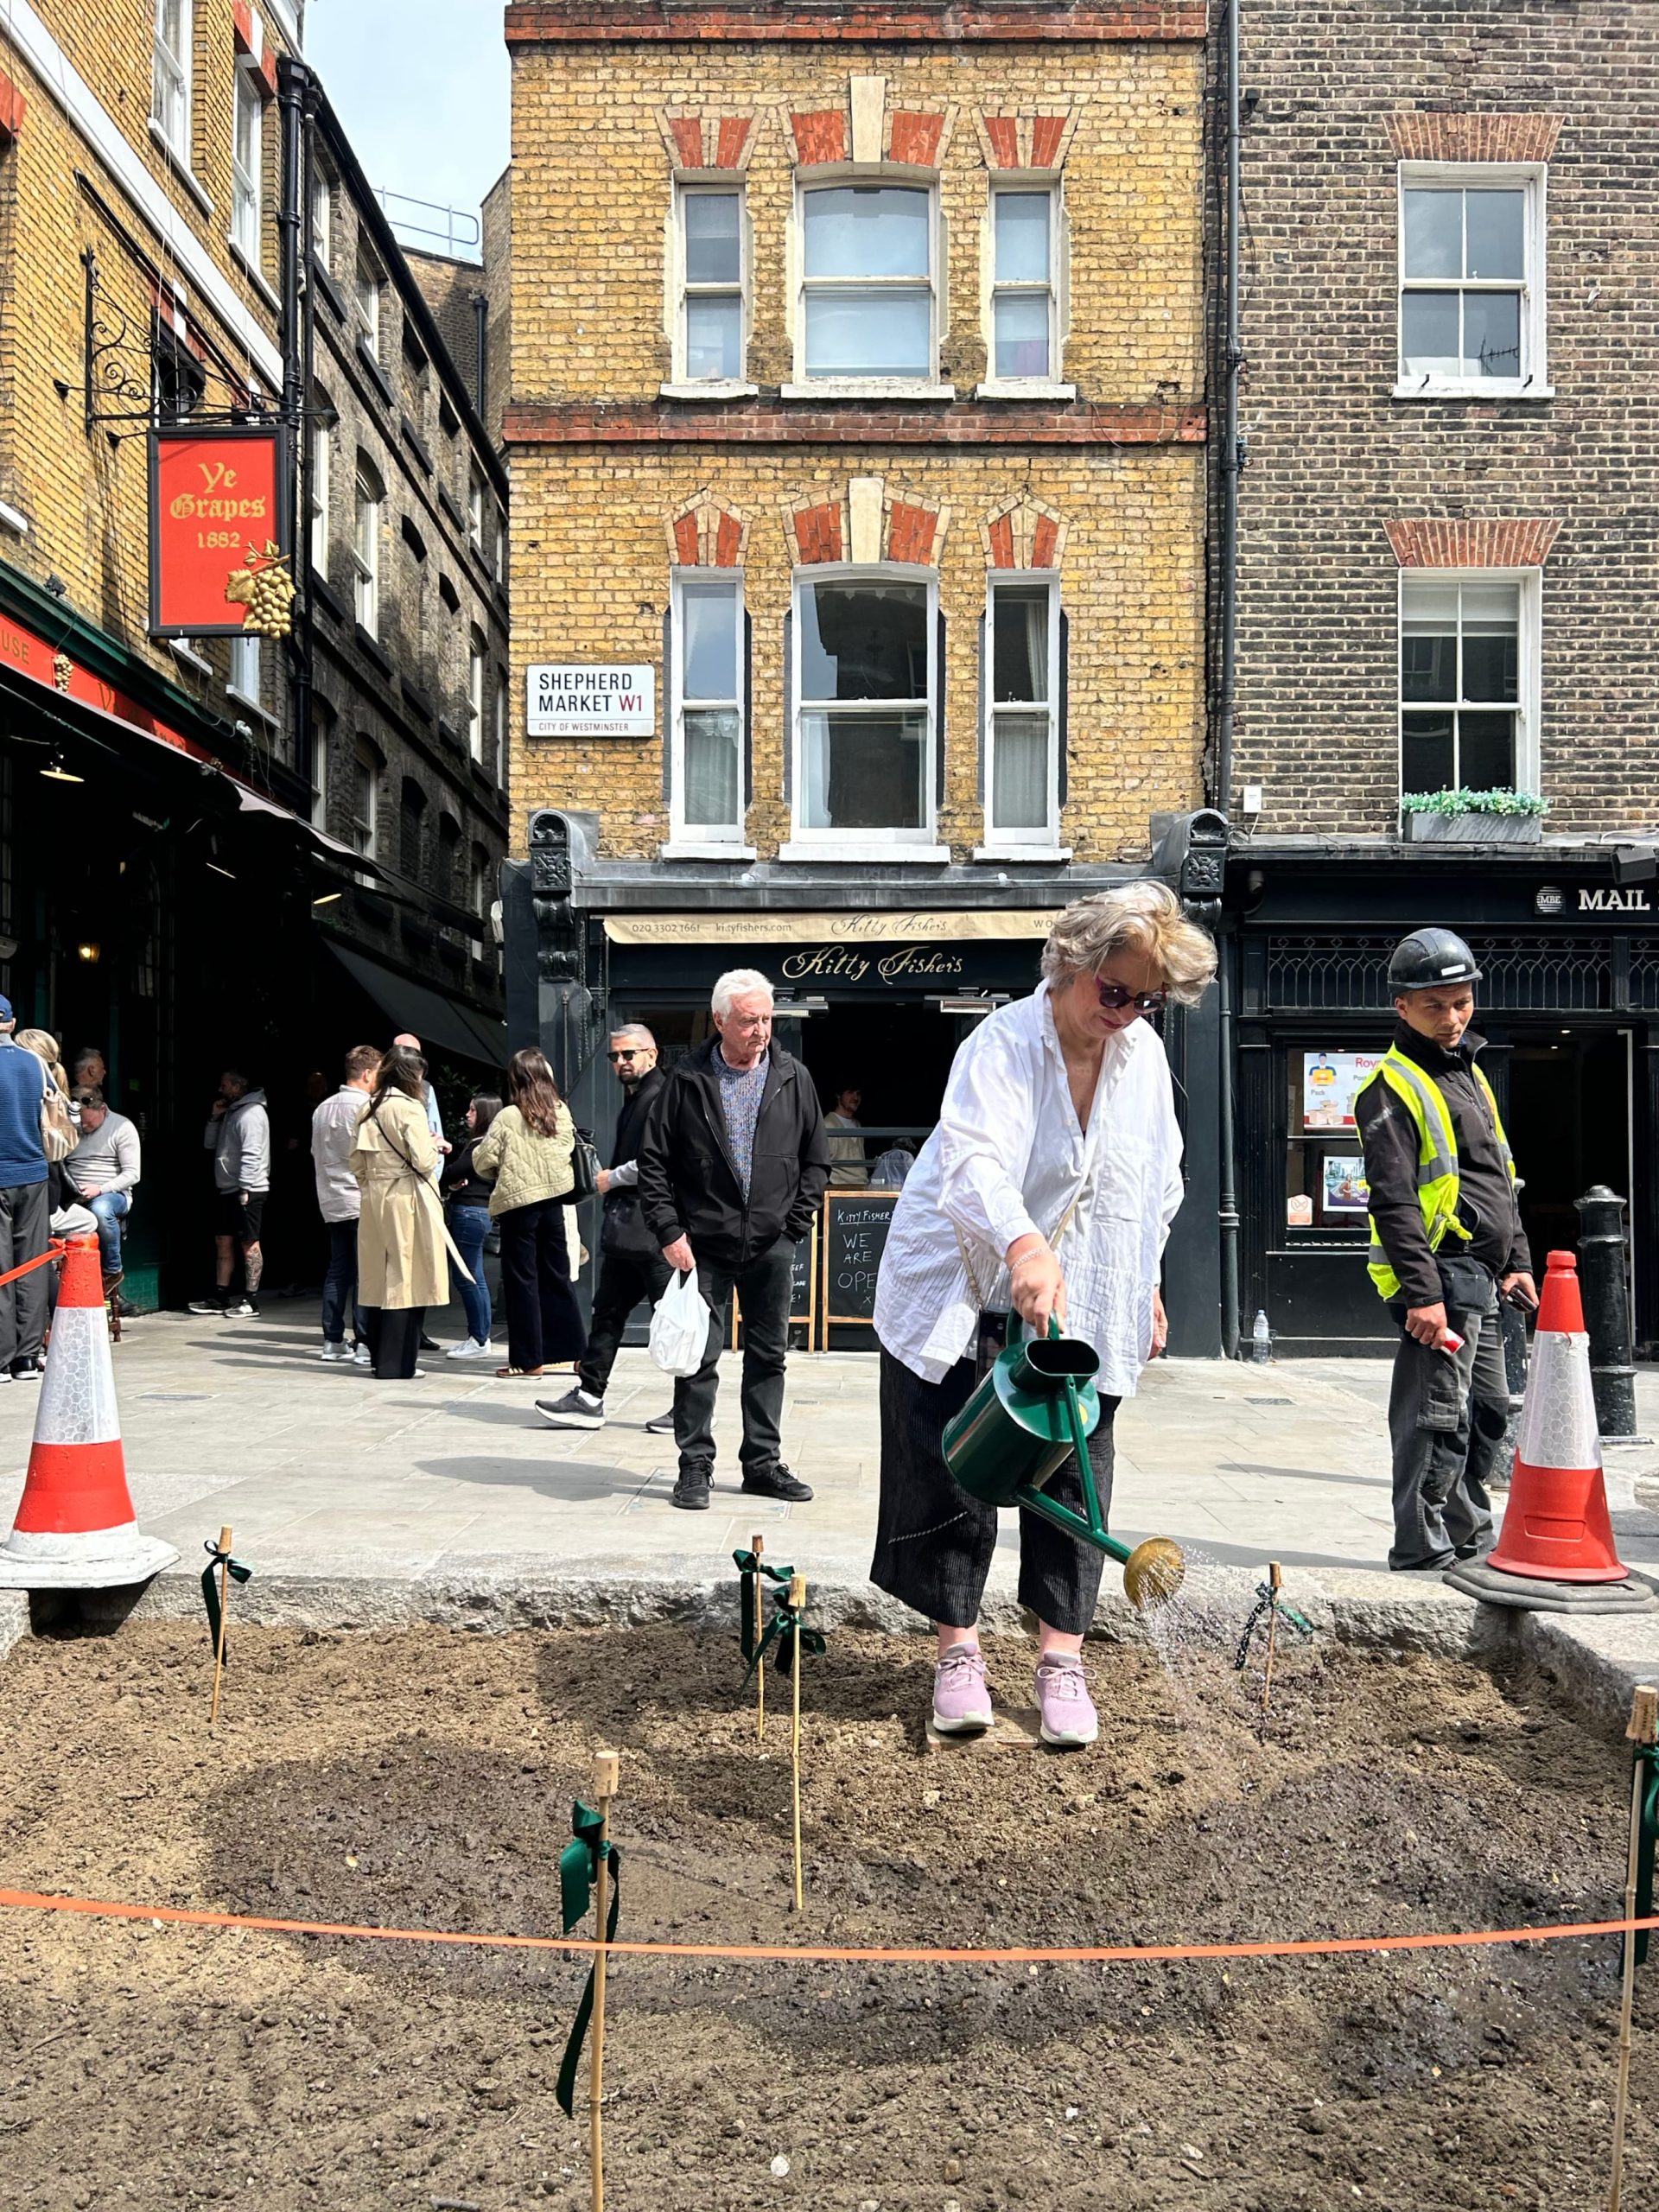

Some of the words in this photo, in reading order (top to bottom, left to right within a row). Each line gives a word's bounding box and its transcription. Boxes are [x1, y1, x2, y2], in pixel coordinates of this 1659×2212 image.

[197, 461, 238, 494] Ye
[169, 493, 267, 522] Grapes
[197, 531, 241, 549] 1882
[539, 672, 632, 690] SHEPHERD
[538, 695, 613, 712] MARKET
[619, 695, 643, 712] W1
[538, 722, 556, 731] CITY
[559, 722, 569, 731] OF
[571, 722, 629, 731] WESTMINSTER
[1540, 895, 1561, 904] MBE
[1578, 889, 1651, 911] MAIL
[632, 924, 652, 932] 020
[654, 924, 677, 933] 3302
[680, 923, 701, 933] 1661
[715, 922, 792, 935] kiyfishers.com
[831, 913, 887, 935] Kitty
[782, 945, 871, 982] Kitty
[877, 945, 963, 985] Fisher's
[842, 1232, 872, 1249] WE
[842, 1250, 873, 1265] ARE
